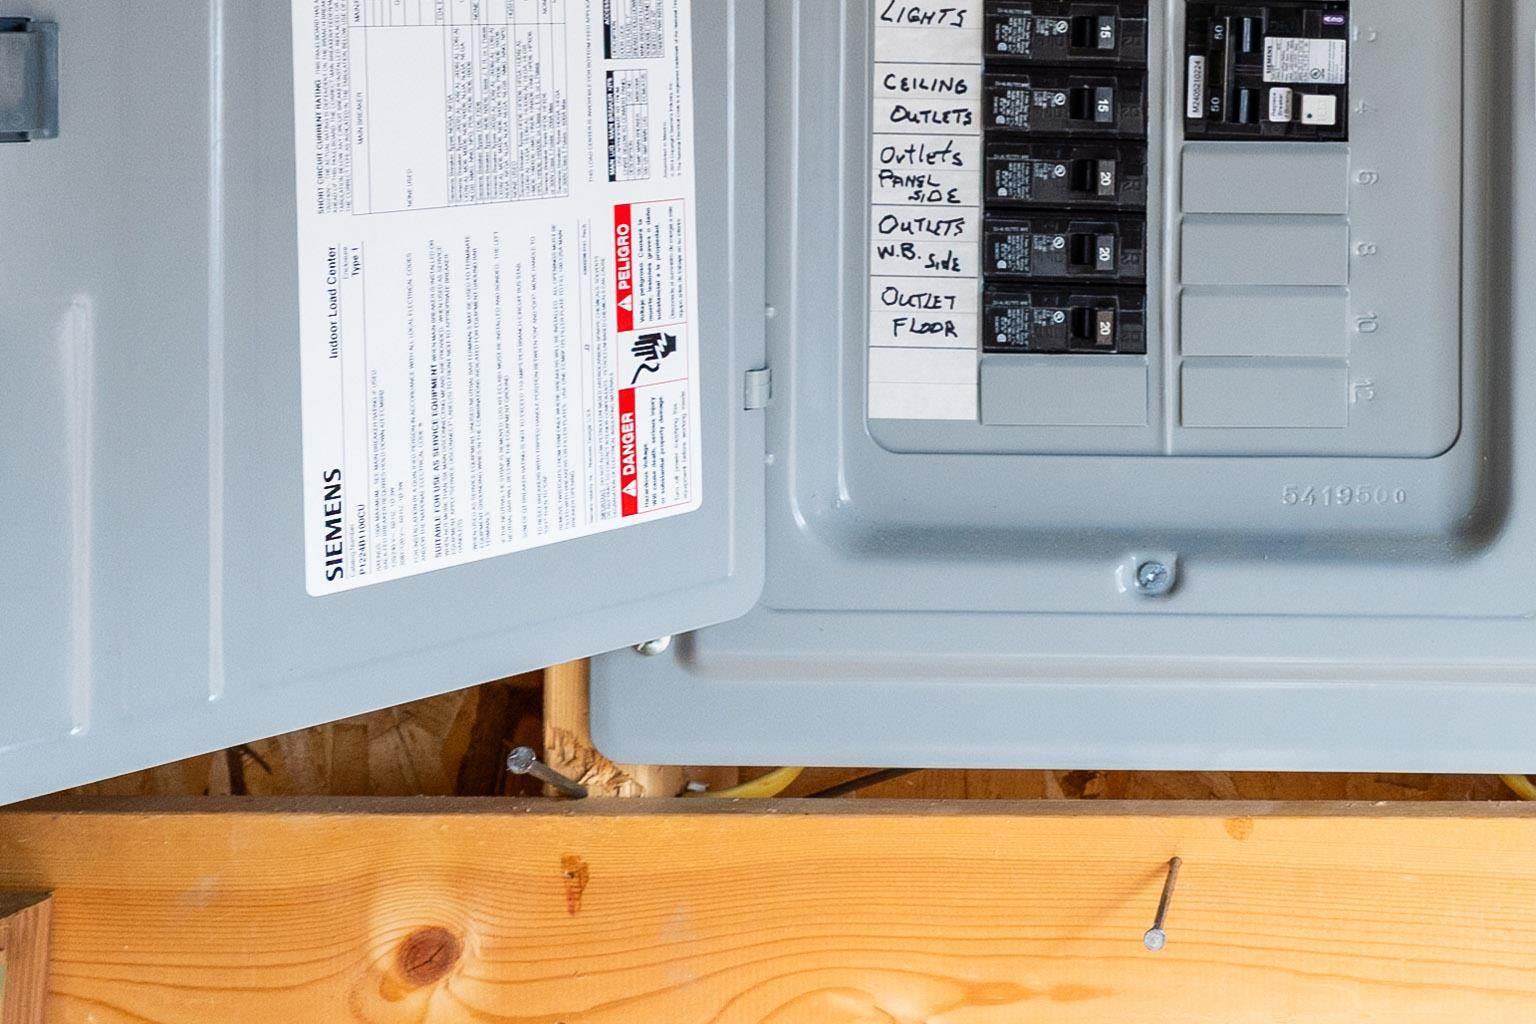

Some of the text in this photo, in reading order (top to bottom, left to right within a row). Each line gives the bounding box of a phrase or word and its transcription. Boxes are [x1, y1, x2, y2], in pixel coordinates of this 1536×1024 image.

[1100, 25, 1111, 38] 15
[1214, 25, 1224, 40] 50
[1265, 45, 1273, 74] SIEMENS
[883, 73, 968, 94] CEILING
[1191, 60, 1201, 113] M2405210224
[1098, 99, 1109, 112] 15
[1210, 97, 1220, 112] 50
[878, 169, 940, 188] PANEL
[1100, 172, 1111, 186] 20
[908, 188, 961, 203] SIDE
[616, 223, 631, 290] PELIGRO
[877, 242, 921, 260] W.B.
[1099, 247, 1110, 261] 20
[350, 254, 361, 276] Type
[326, 246, 339, 359] Indoor Load Center
[881, 286, 956, 310] OUTLET
[893, 317, 958, 338] FLOOR
[1100, 322, 1111, 336] 20
[621, 412, 636, 476] DANGER
[323, 468, 344, 581] SIEMENS
